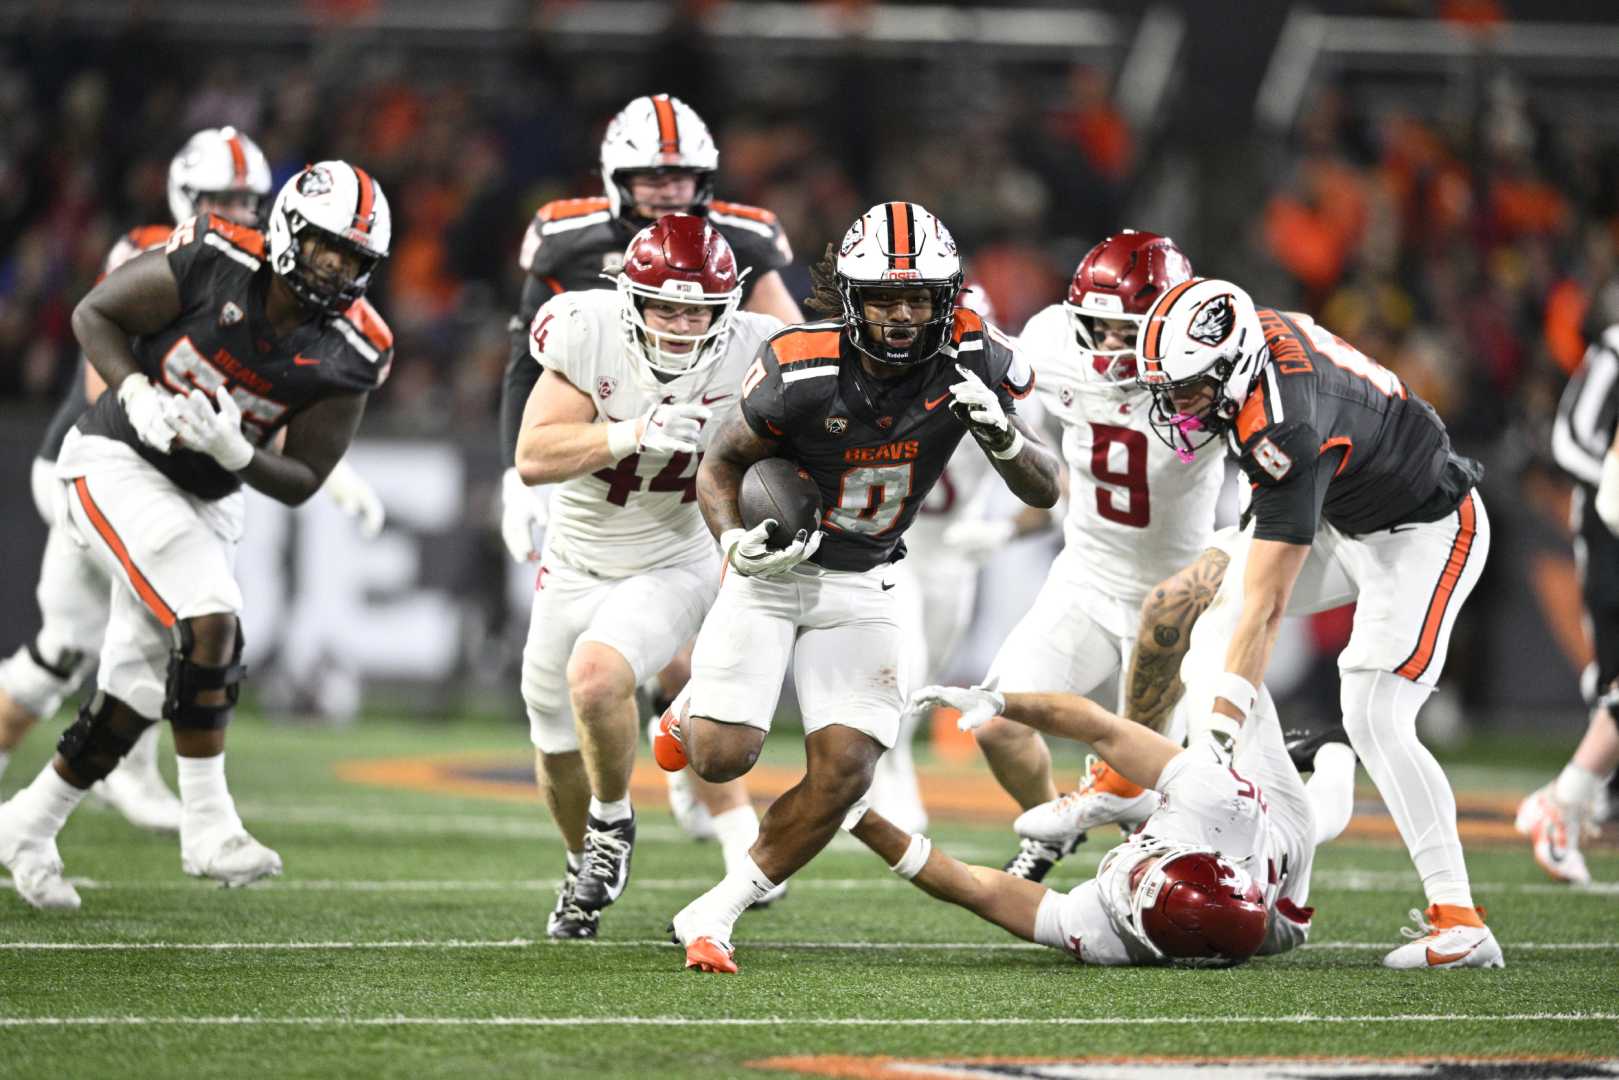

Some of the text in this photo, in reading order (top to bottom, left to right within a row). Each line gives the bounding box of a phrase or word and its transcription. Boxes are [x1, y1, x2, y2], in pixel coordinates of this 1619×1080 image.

[844, 440, 920, 464] BEAVS
[1088, 421, 1151, 529] 9
[1252, 435, 1293, 481] 8
[821, 461, 913, 538] 0
